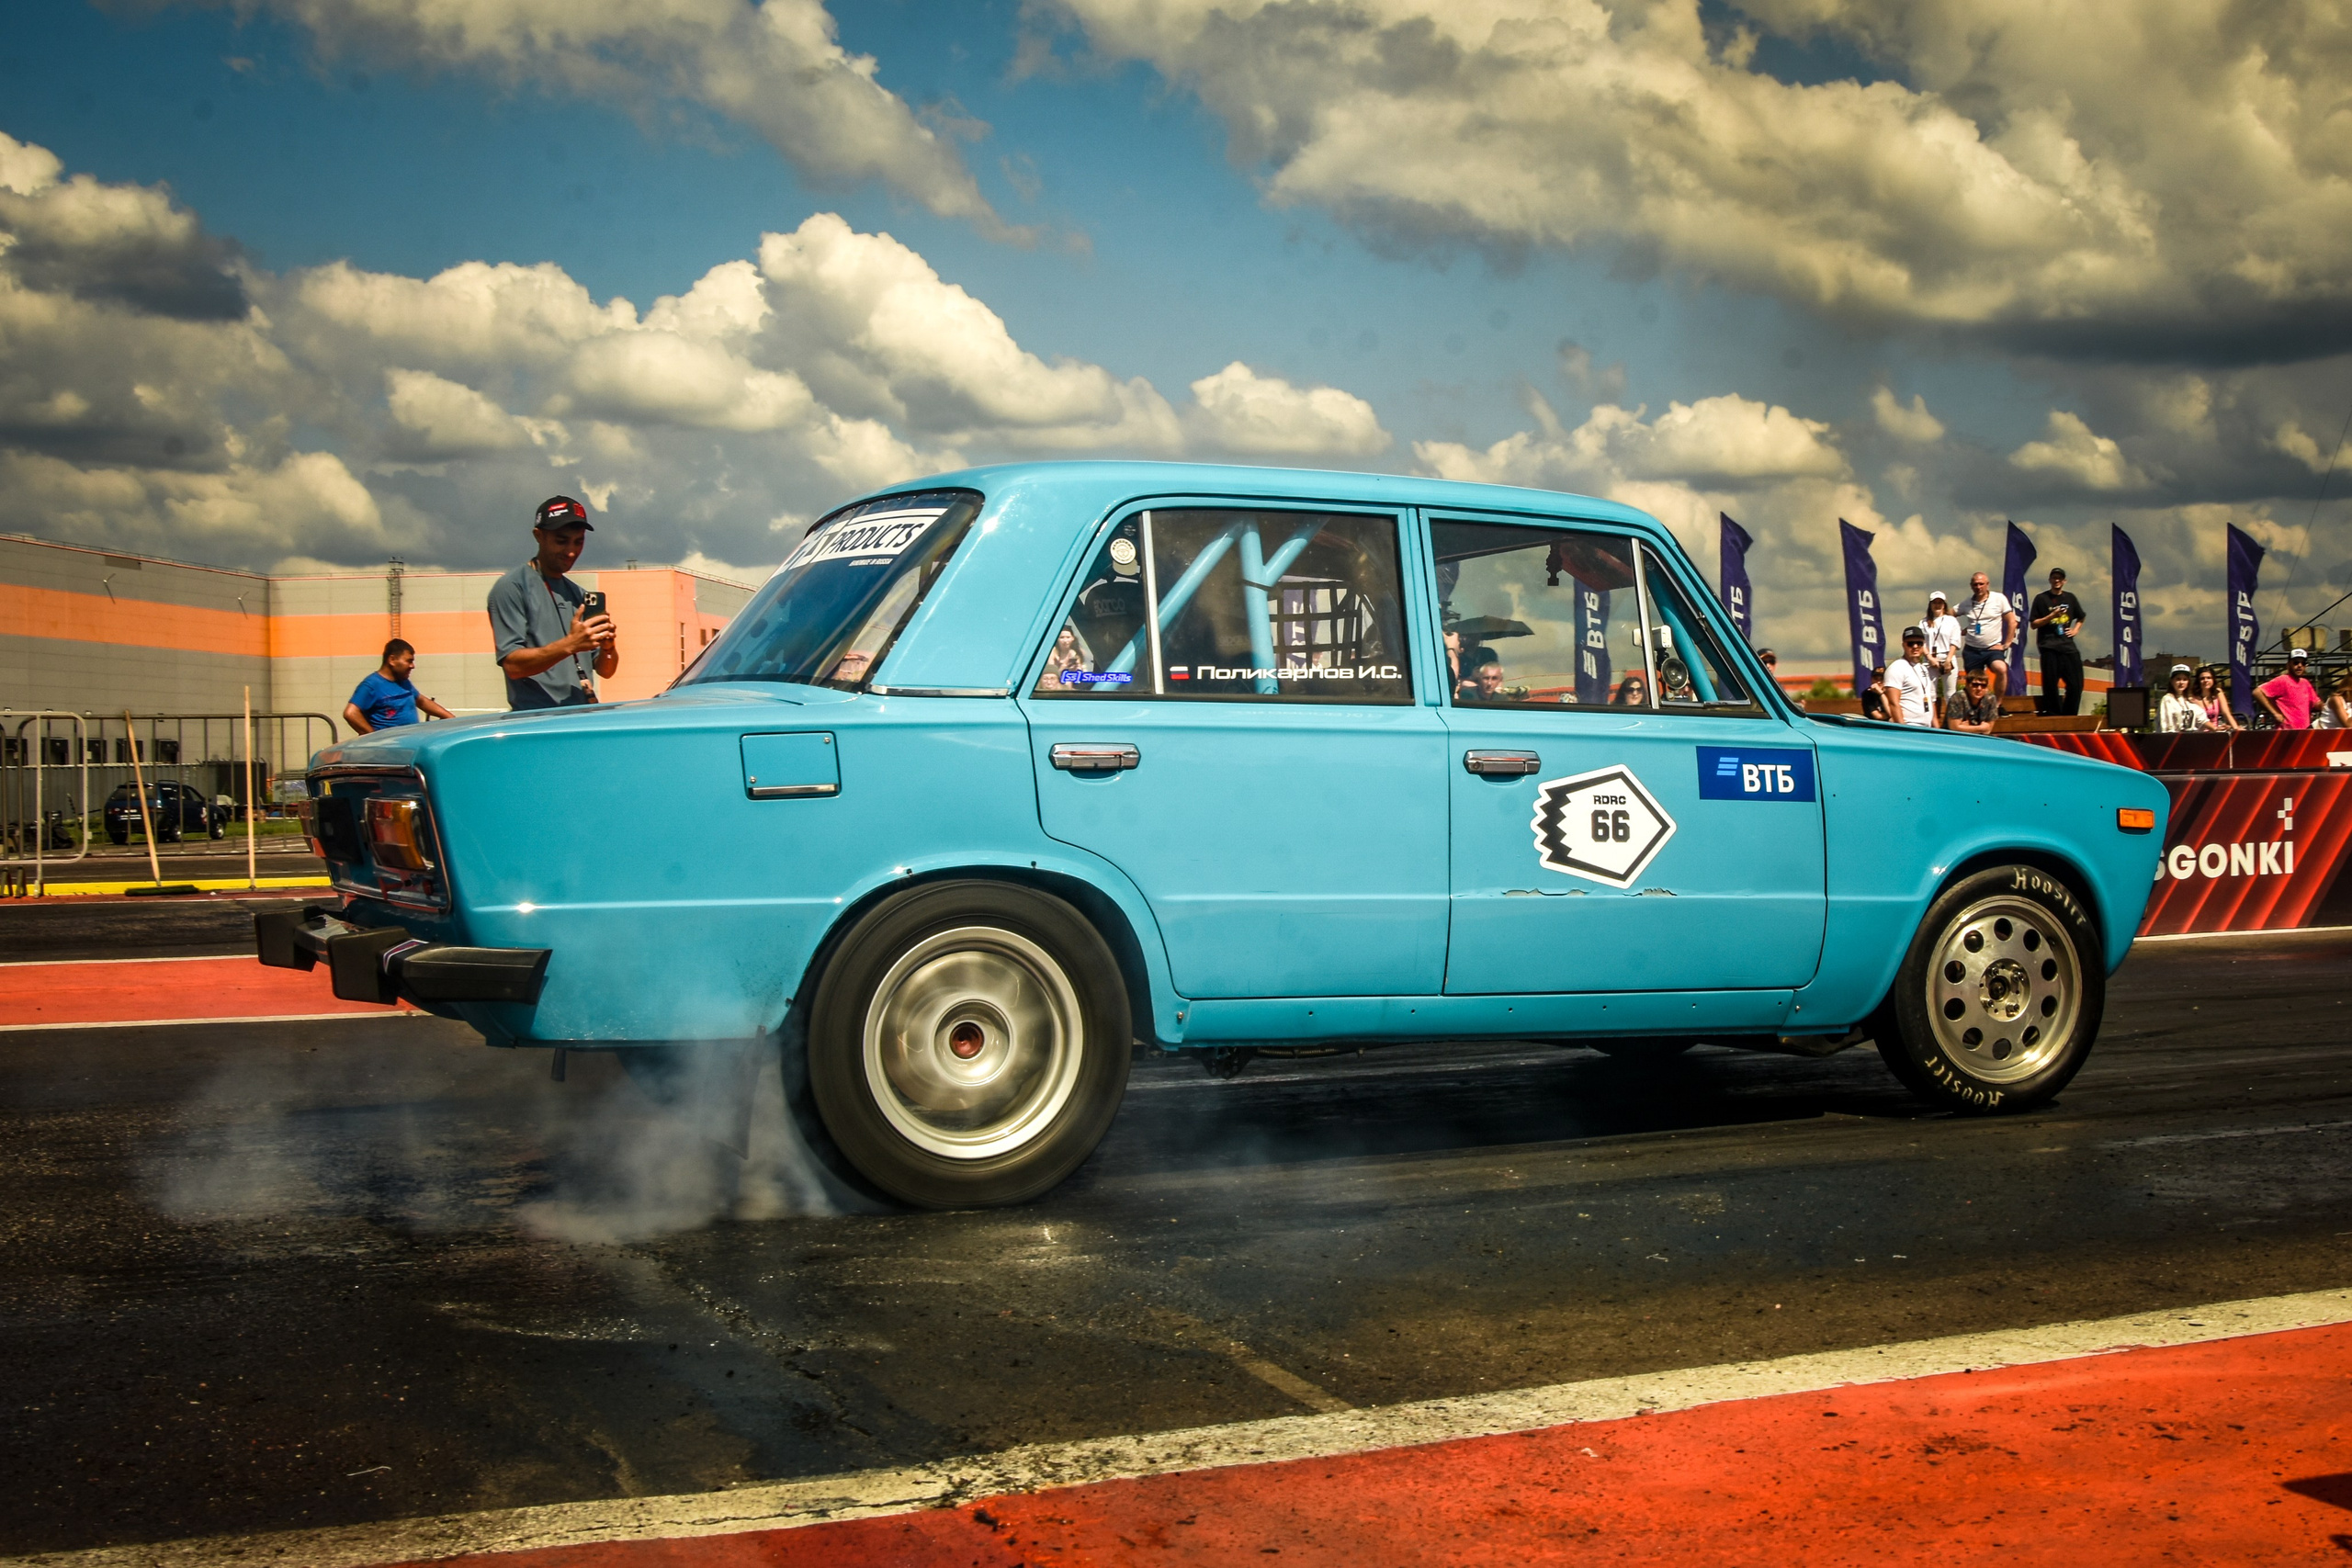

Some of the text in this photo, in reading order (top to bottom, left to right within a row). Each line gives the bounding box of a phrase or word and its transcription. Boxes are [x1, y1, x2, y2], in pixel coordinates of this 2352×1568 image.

[829, 523, 925, 555] PRODUCTS
[1583, 592, 1605, 649] ВТБ
[1730, 585, 1744, 631] ТБ
[1858, 589, 1878, 644] ВТБ
[1081, 673, 1106, 682] Shed
[1107, 673, 1132, 682] Skills
[1197, 665, 1402, 682] Поликарпов И.С.
[1742, 763, 1795, 794] ВТБ
[1593, 795, 1627, 806] RDRC
[1591, 809, 1631, 843] 66
